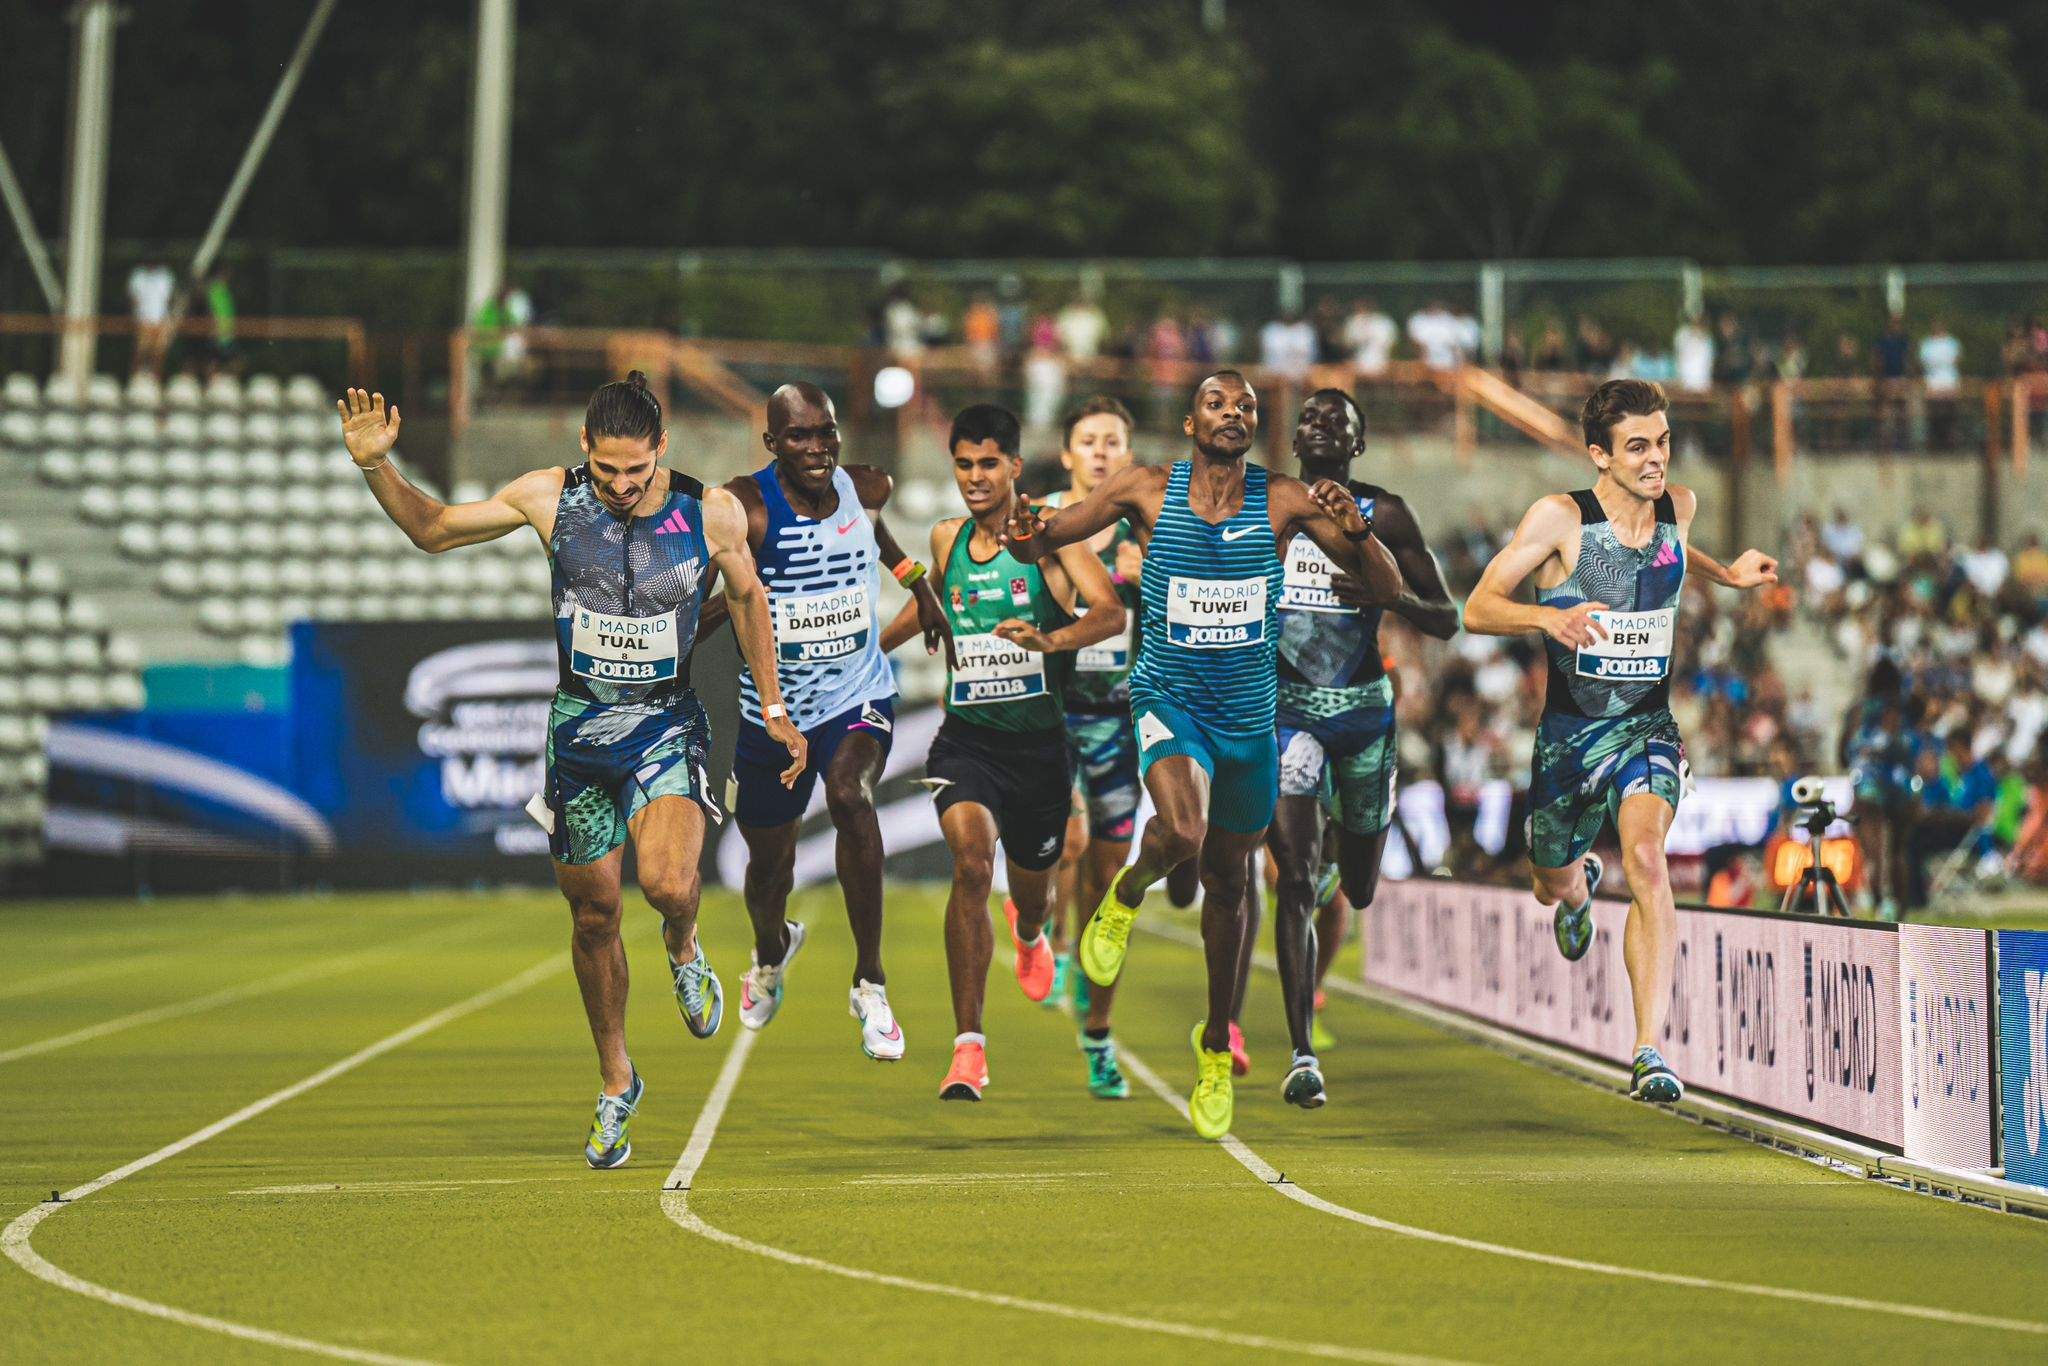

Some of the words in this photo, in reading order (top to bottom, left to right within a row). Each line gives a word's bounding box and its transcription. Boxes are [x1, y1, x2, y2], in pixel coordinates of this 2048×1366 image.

[1297, 561, 1330, 575] BOL
[1197, 583, 1260, 599] MADRID
[806, 592, 864, 614] MADRID
[1189, 600, 1248, 614] TUWEI
[789, 607, 862, 630] DADRIGA
[1217, 617, 1224, 625] 3
[1610, 615, 1668, 630] MADRID
[600, 619, 667, 635] MADRID
[826, 630, 837, 638] 11
[597, 634, 649, 650] TUAL
[1613, 632, 1650, 645] BEN
[960, 651, 1030, 669] ATTAOUI
[1630, 649, 1636, 657] 7
[1729, 948, 1775, 1068] MADRID
[1820, 959, 1877, 1094] MADRID
[1924, 992, 1979, 1102] MADRID
